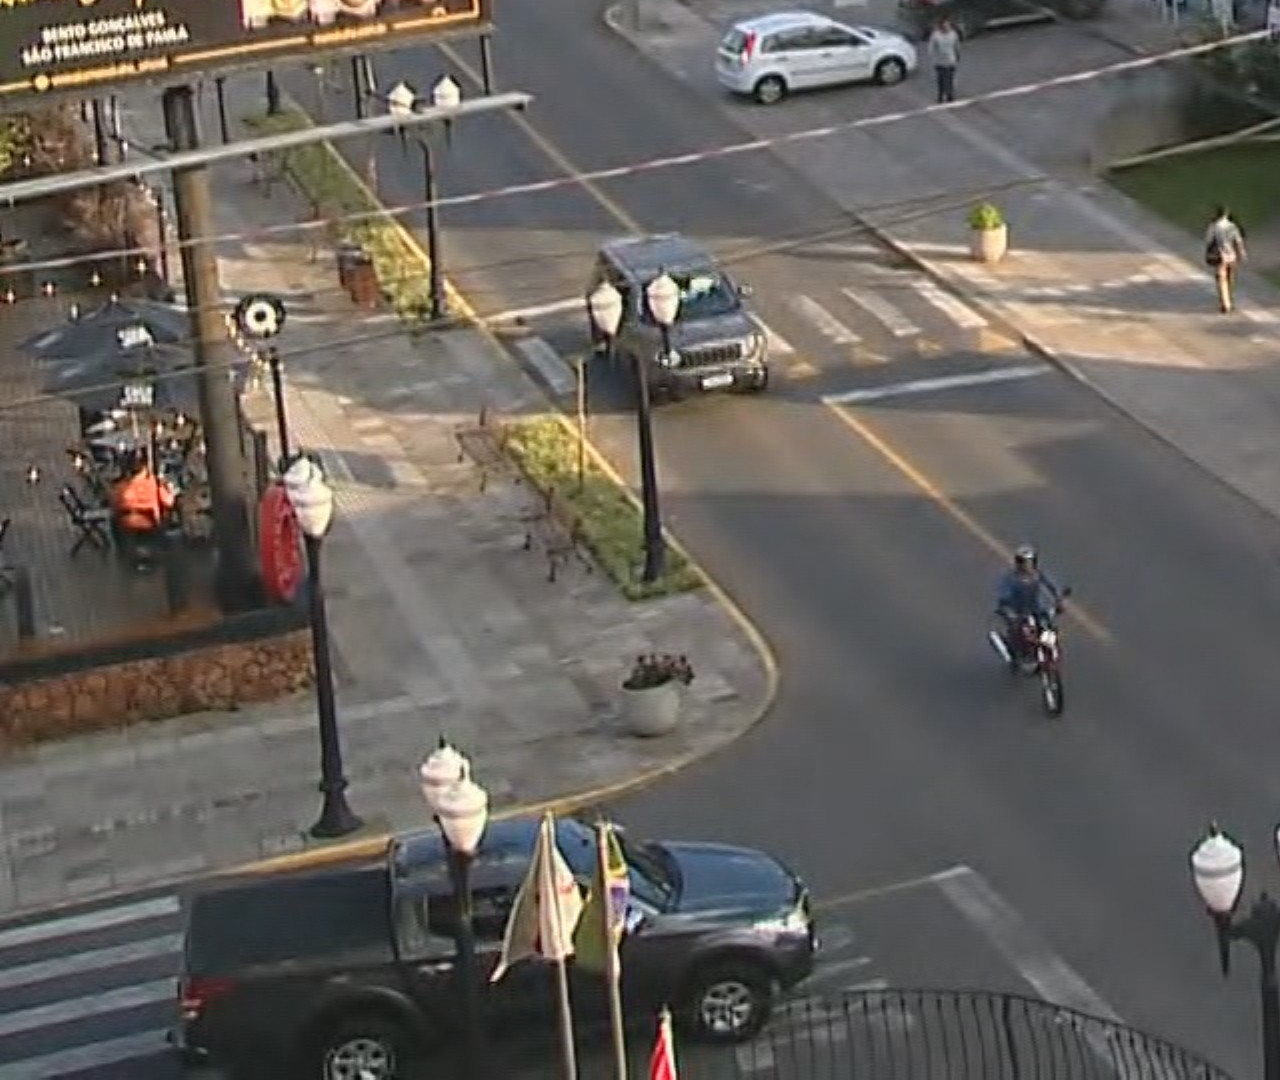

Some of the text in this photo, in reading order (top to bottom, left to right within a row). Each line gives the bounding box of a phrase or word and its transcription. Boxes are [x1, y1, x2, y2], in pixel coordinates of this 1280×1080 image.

[42, 22, 86, 43] BENTO
[127, 33, 144, 49] DE
[147, 23, 190, 47] PAULA
